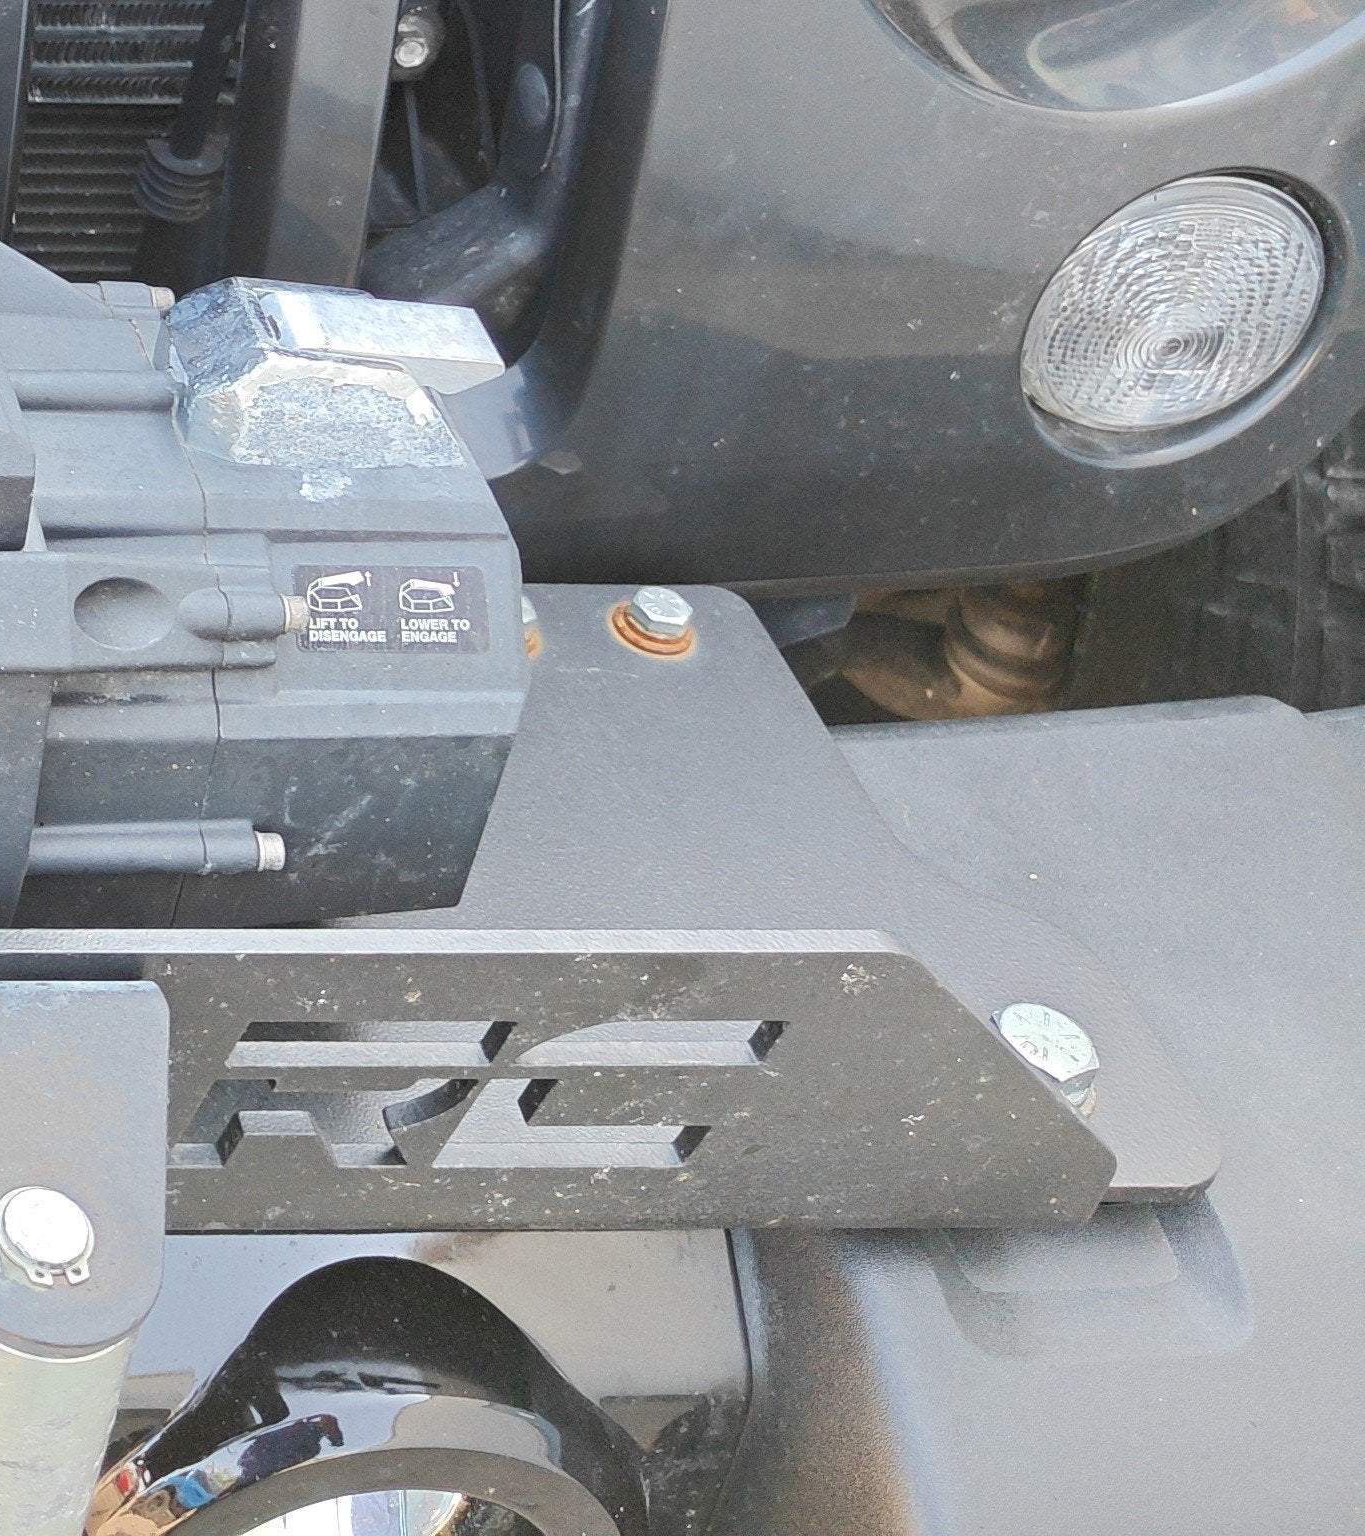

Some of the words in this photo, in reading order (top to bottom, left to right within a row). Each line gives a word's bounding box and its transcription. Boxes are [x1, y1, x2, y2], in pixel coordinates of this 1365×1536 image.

[309, 618, 337, 629] LIFT
[339, 618, 358, 629] TO
[400, 619, 448, 630] LOWER
[451, 619, 470, 630] TO
[309, 631, 386, 642] DISENGAGE
[401, 631, 457, 642] ENGAGE
